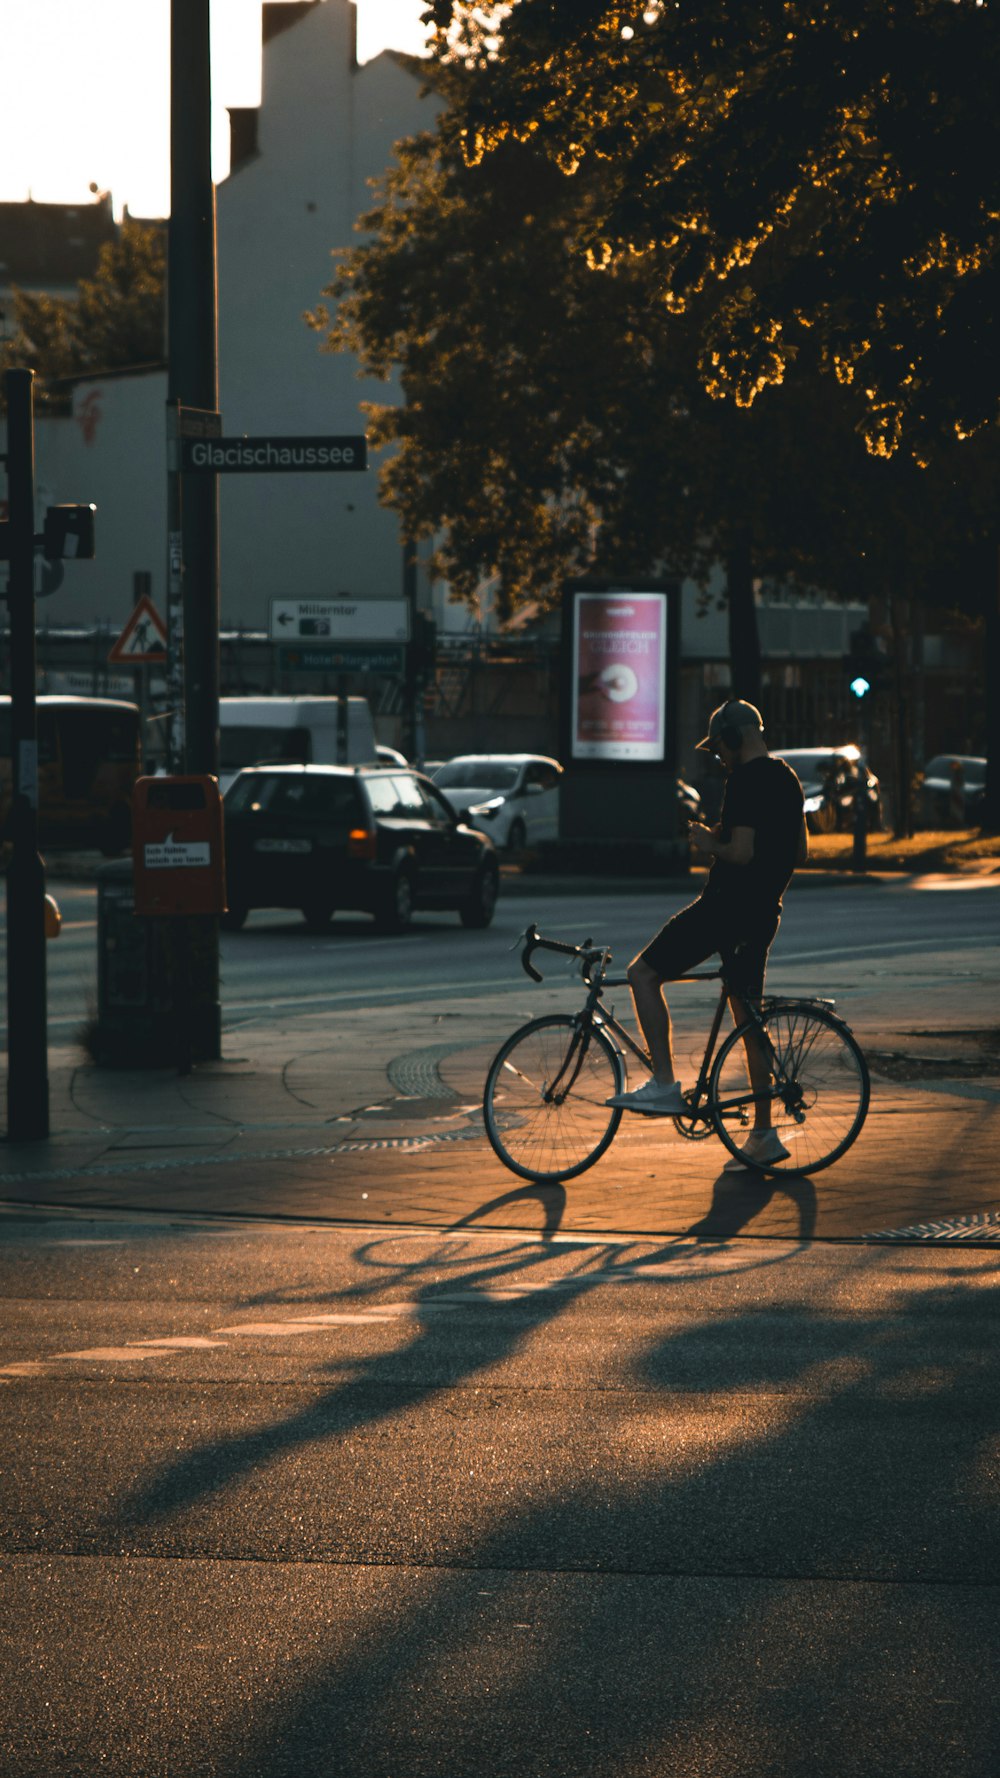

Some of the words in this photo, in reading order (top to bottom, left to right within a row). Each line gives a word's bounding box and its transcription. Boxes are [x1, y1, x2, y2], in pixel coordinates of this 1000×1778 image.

[192, 443, 355, 466] Glacischaussee
[299, 605, 358, 616] Millerntor
[146, 856, 169, 864] mich
